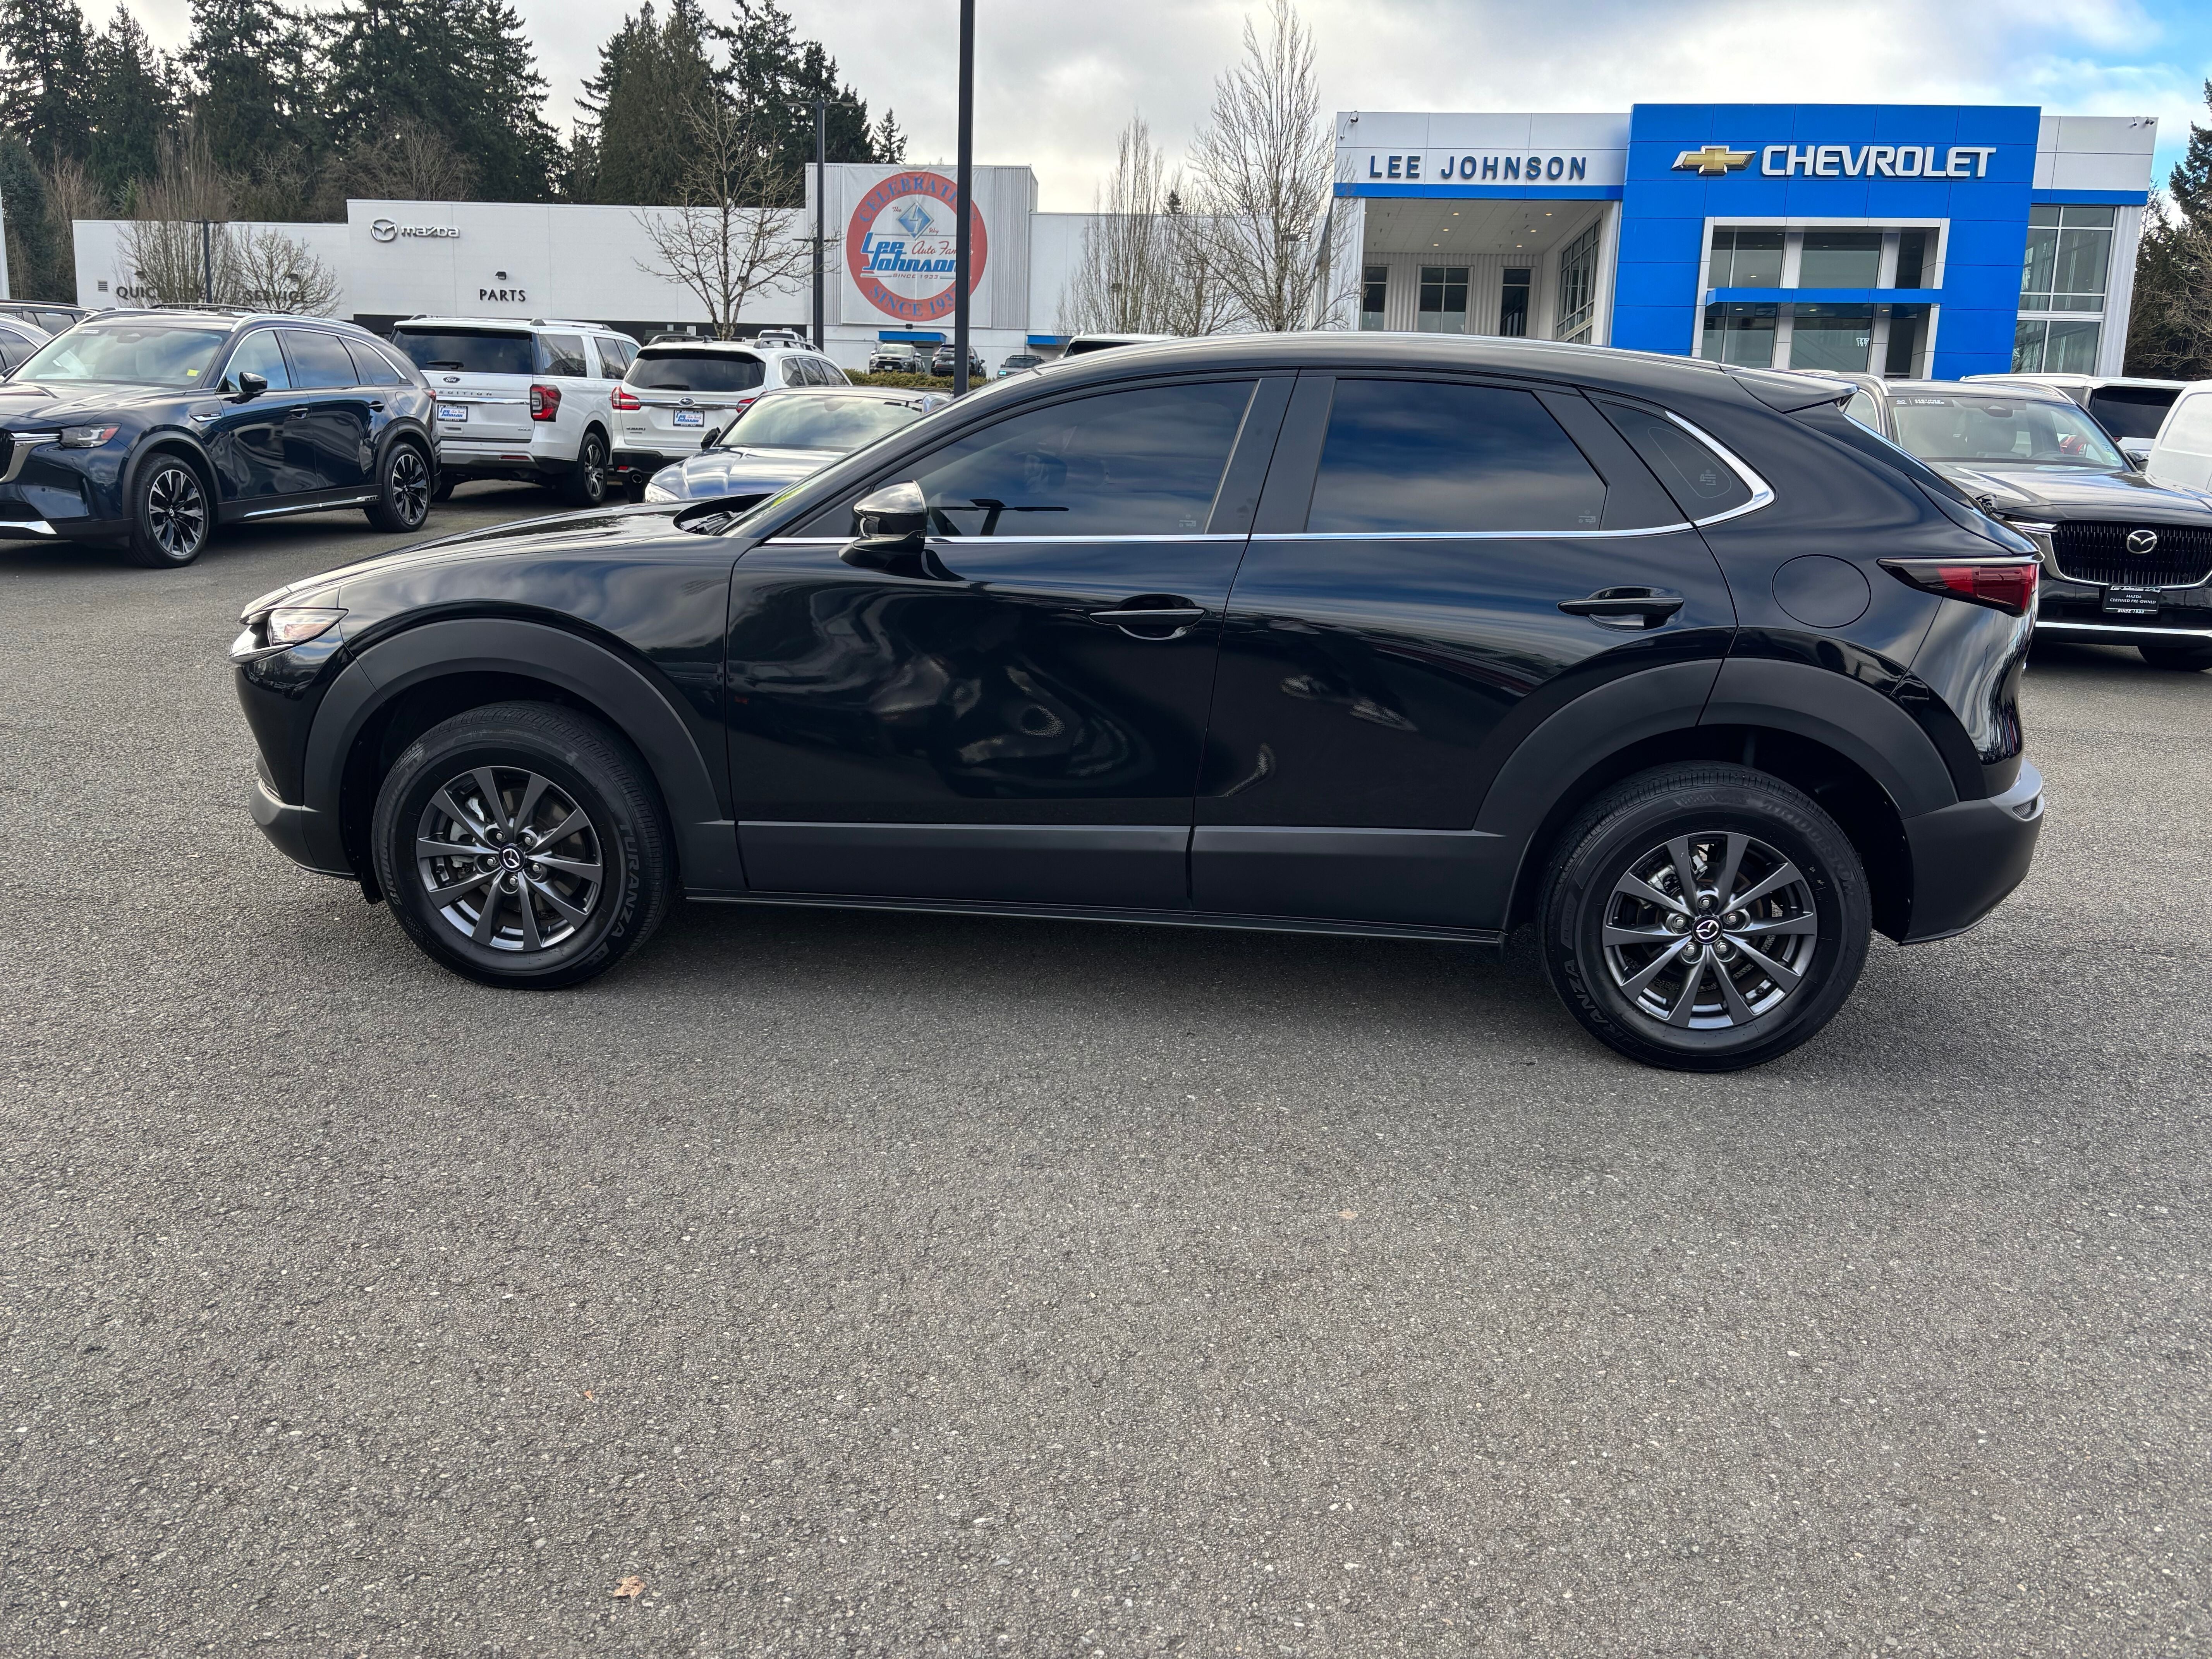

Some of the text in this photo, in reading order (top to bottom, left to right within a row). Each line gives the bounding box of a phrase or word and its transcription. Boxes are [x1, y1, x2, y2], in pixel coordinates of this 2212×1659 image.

[1369, 155, 1587, 180] LEE JOHNSON
[1762, 145, 1997, 177] CHEVROLET
[859, 176, 976, 222] CELEBRATI
[401, 225, 460, 238] mazda
[862, 232, 907, 254] Lee
[912, 240, 937, 255] Auto
[116, 286, 158, 300] QUIC
[479, 289, 526, 302] PARTS
[869, 285, 955, 316] SINCE 193
[611, 823, 640, 938] TURANZA
